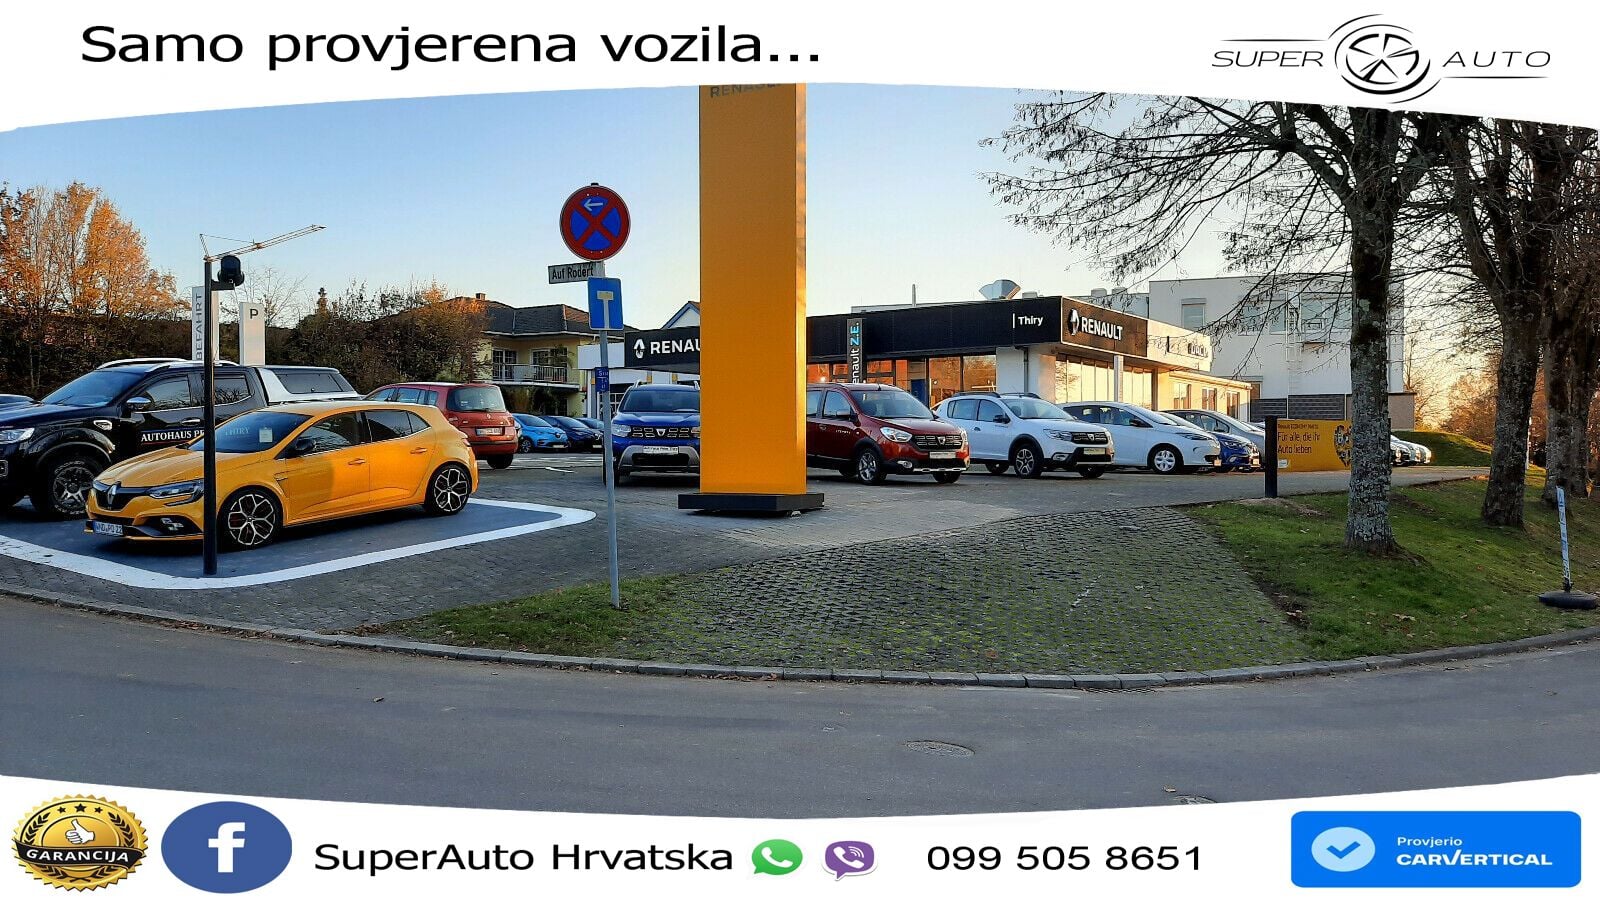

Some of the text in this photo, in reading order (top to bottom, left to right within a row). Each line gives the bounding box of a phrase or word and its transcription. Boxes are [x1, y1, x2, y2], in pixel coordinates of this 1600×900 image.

[552, 268, 565, 280] Auf
[249, 308, 259, 319] P
[1018, 315, 1043, 327] Thiry
[850, 322, 860, 346] Z.E.
[1081, 317, 1123, 340] RENAULT
[141, 431, 192, 442] AUTOHAUS
[1302, 432, 1312, 441] die
[1278, 444, 1312, 454] Auto lieben
